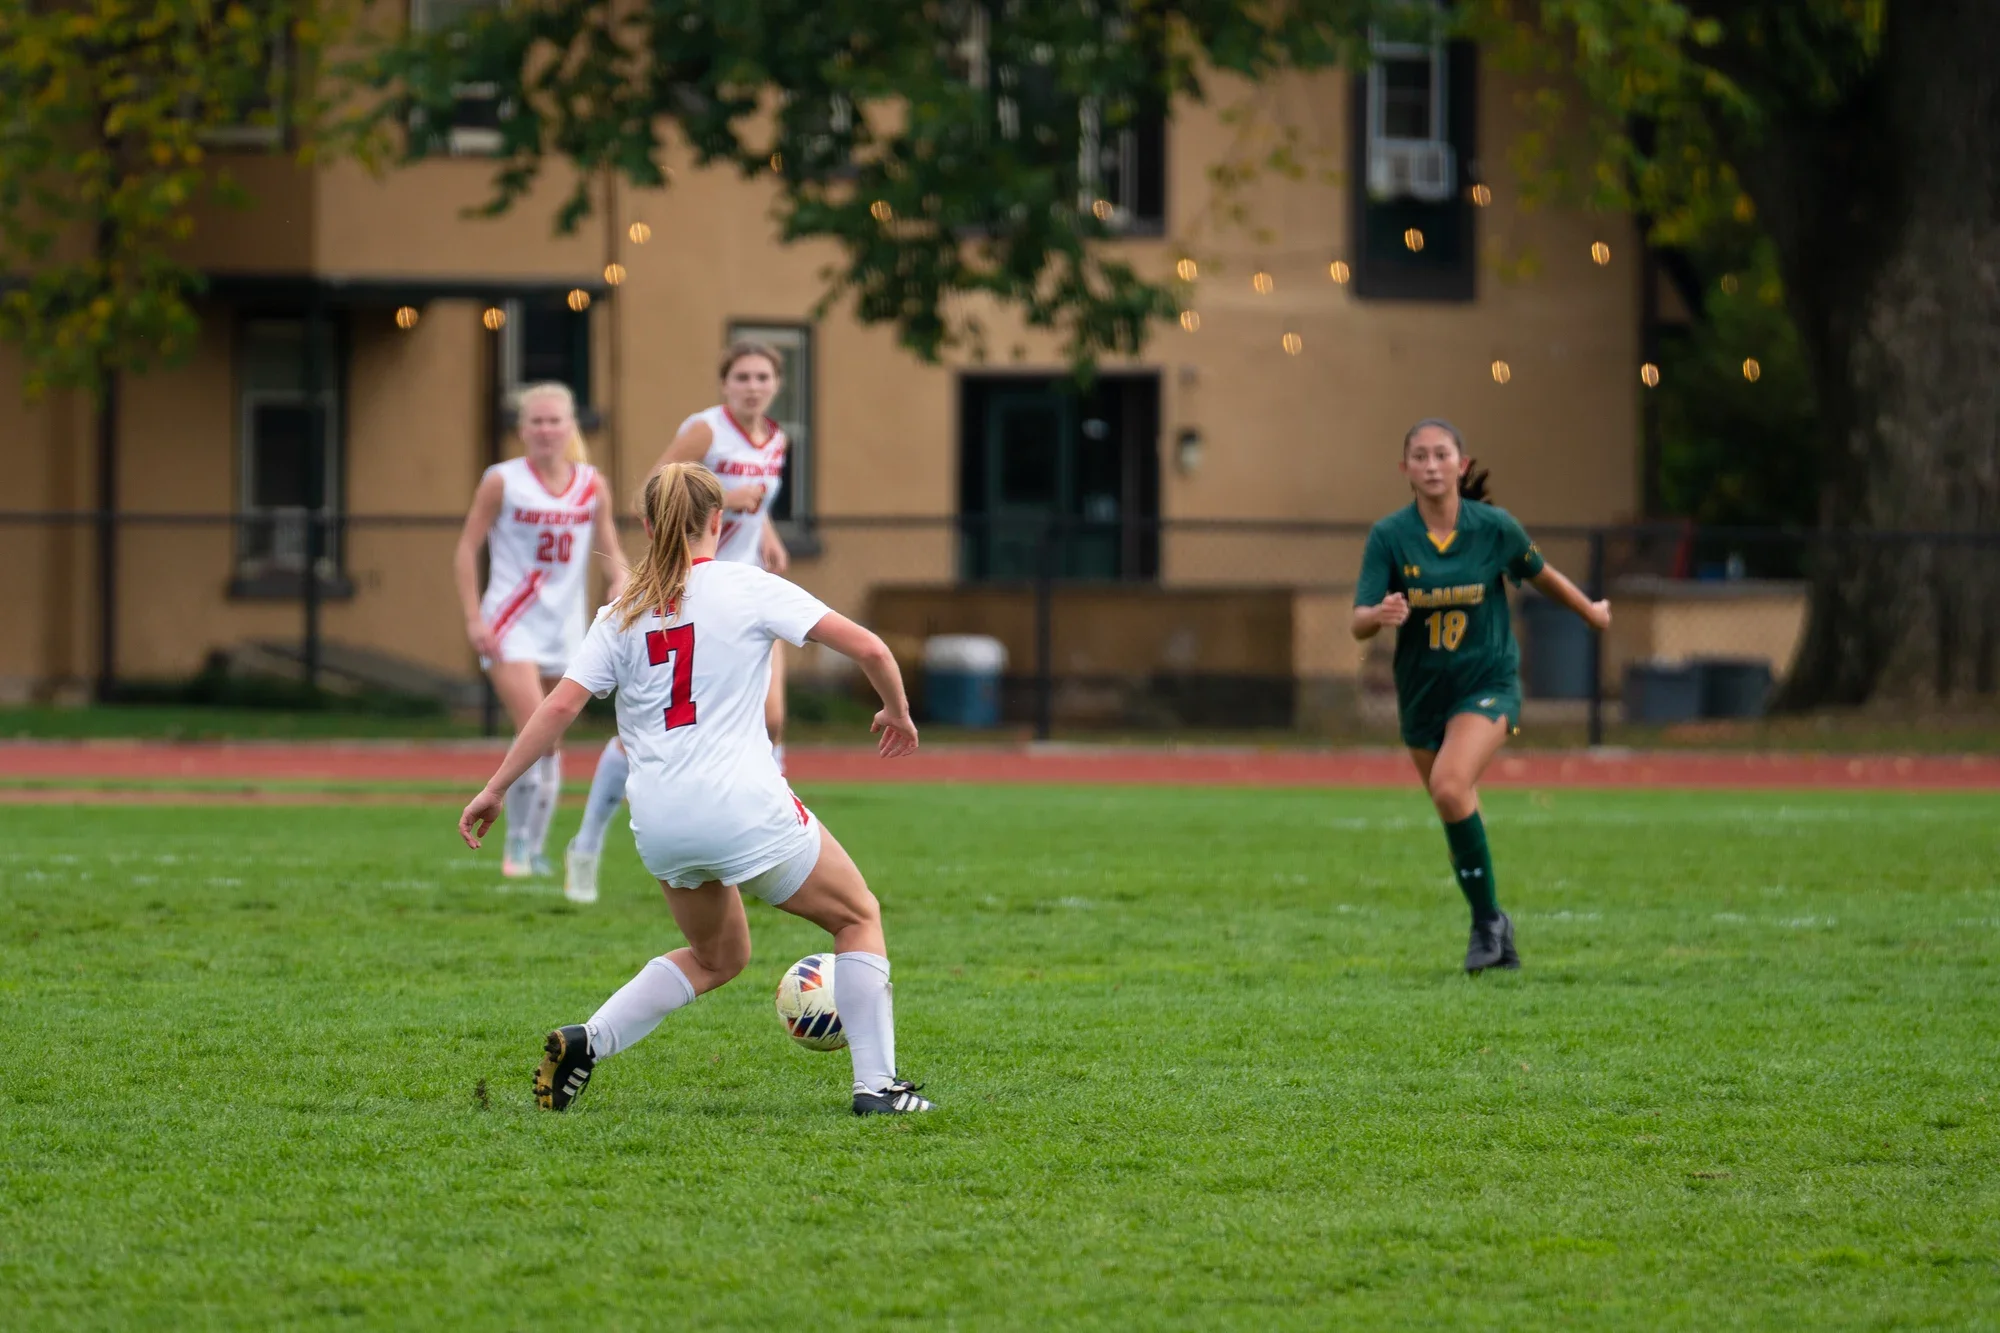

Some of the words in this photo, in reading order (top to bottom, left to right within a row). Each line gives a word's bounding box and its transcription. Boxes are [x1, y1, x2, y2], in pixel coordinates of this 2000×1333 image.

[536, 531, 574, 563] 20
[1424, 609, 1467, 651] 18
[645, 622, 697, 731] 7
